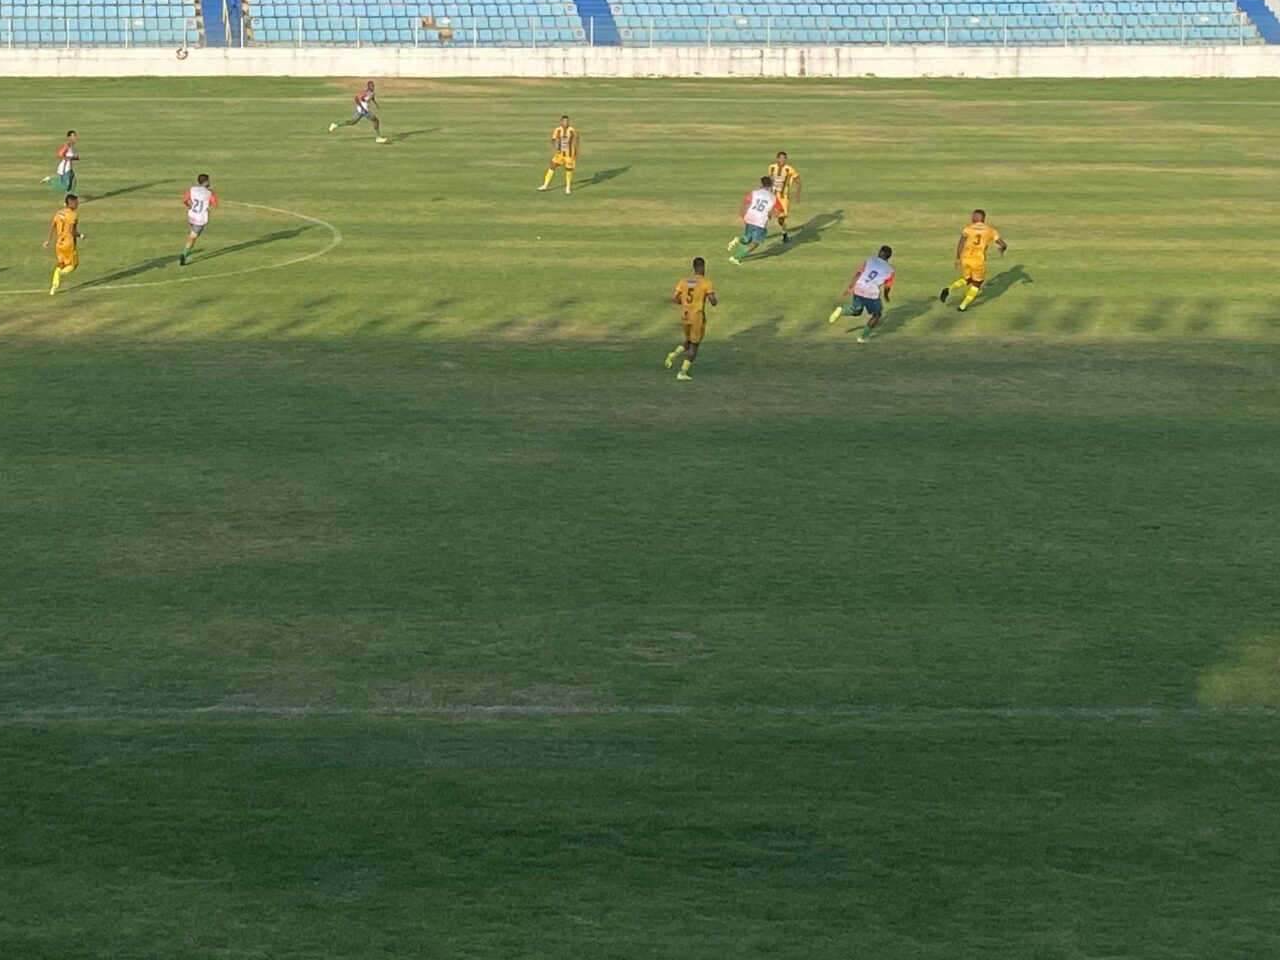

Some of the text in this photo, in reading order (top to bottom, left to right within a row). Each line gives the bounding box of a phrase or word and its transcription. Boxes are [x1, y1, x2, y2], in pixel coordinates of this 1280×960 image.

[192, 199, 204, 213] 21
[973, 234, 982, 246] 3
[865, 270, 878, 283] 9
